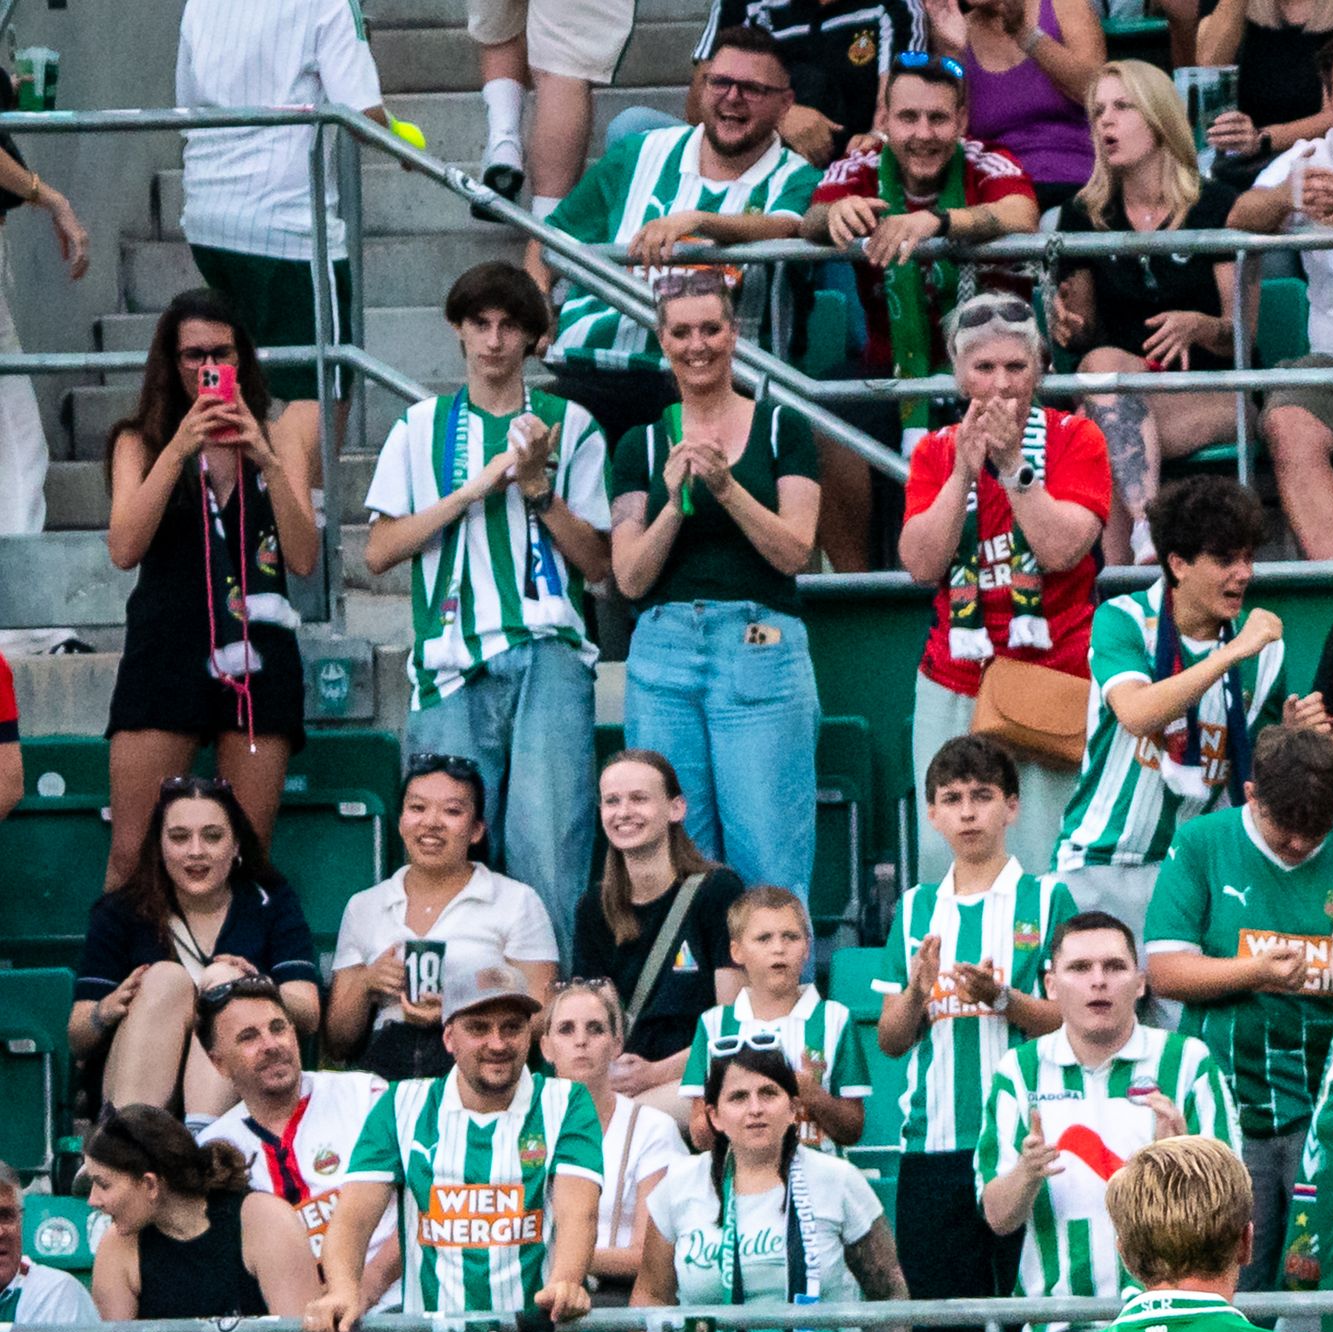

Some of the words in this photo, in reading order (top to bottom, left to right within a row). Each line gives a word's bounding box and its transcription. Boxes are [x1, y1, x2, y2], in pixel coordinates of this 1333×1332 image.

[1027, 1091, 1081, 1102] DIADORA
[436, 1190, 520, 1214] WIEN
[422, 1215, 537, 1244] ENERGIE
[1140, 1298, 1173, 1313] SCR
